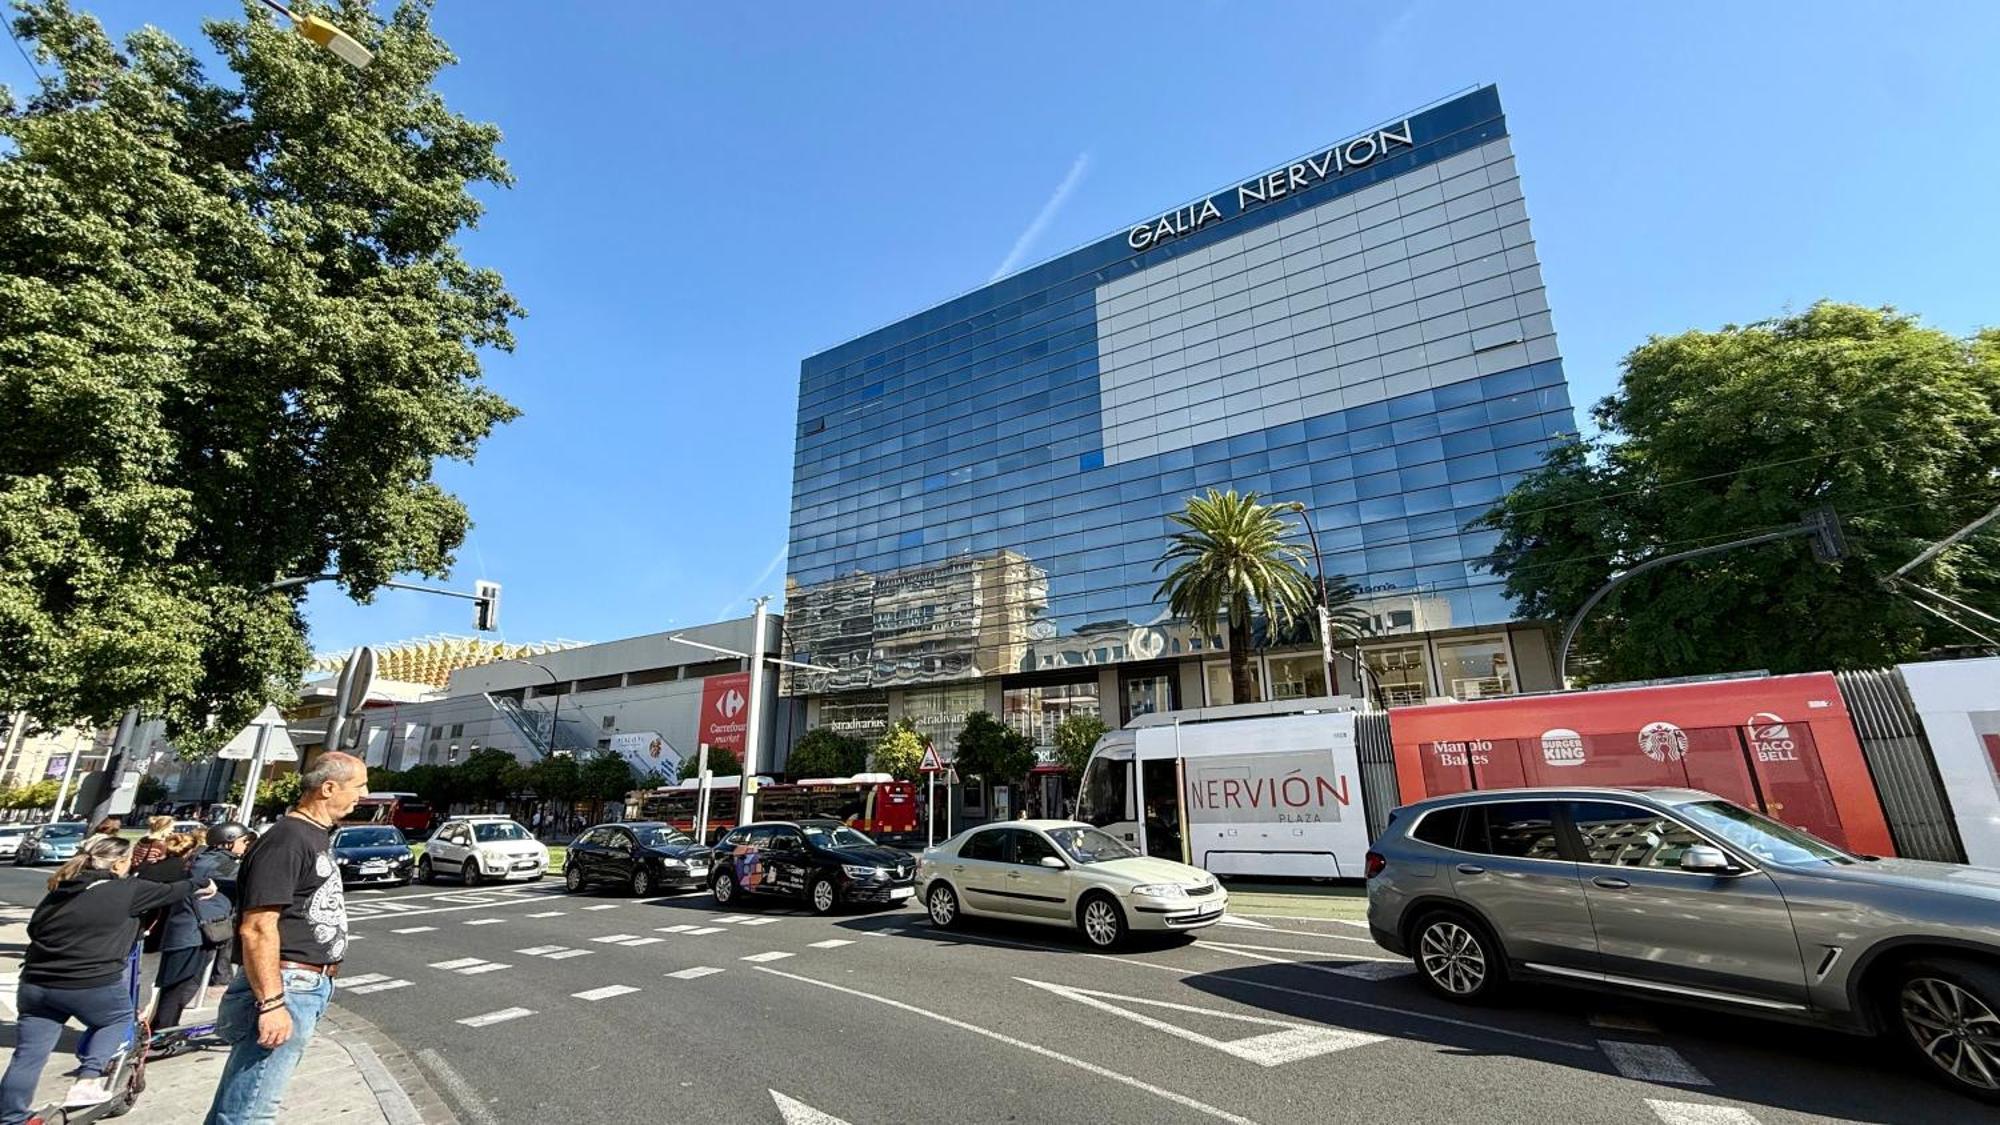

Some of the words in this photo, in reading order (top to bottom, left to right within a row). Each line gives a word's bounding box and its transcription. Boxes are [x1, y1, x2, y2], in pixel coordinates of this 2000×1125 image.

[1128, 195, 1222, 250] GALIA
[1238, 119, 1413, 210] NERVIÓN
[1432, 739, 1493, 754] Manolo
[1542, 739, 1582, 748] BURGER
[1751, 740, 1794, 751] TACO
[1543, 747, 1585, 759] KING
[1758, 751, 1798, 761] BELL
[1191, 768, 1350, 809] NERVIÓN
[1279, 813, 1321, 823] PLAZA
